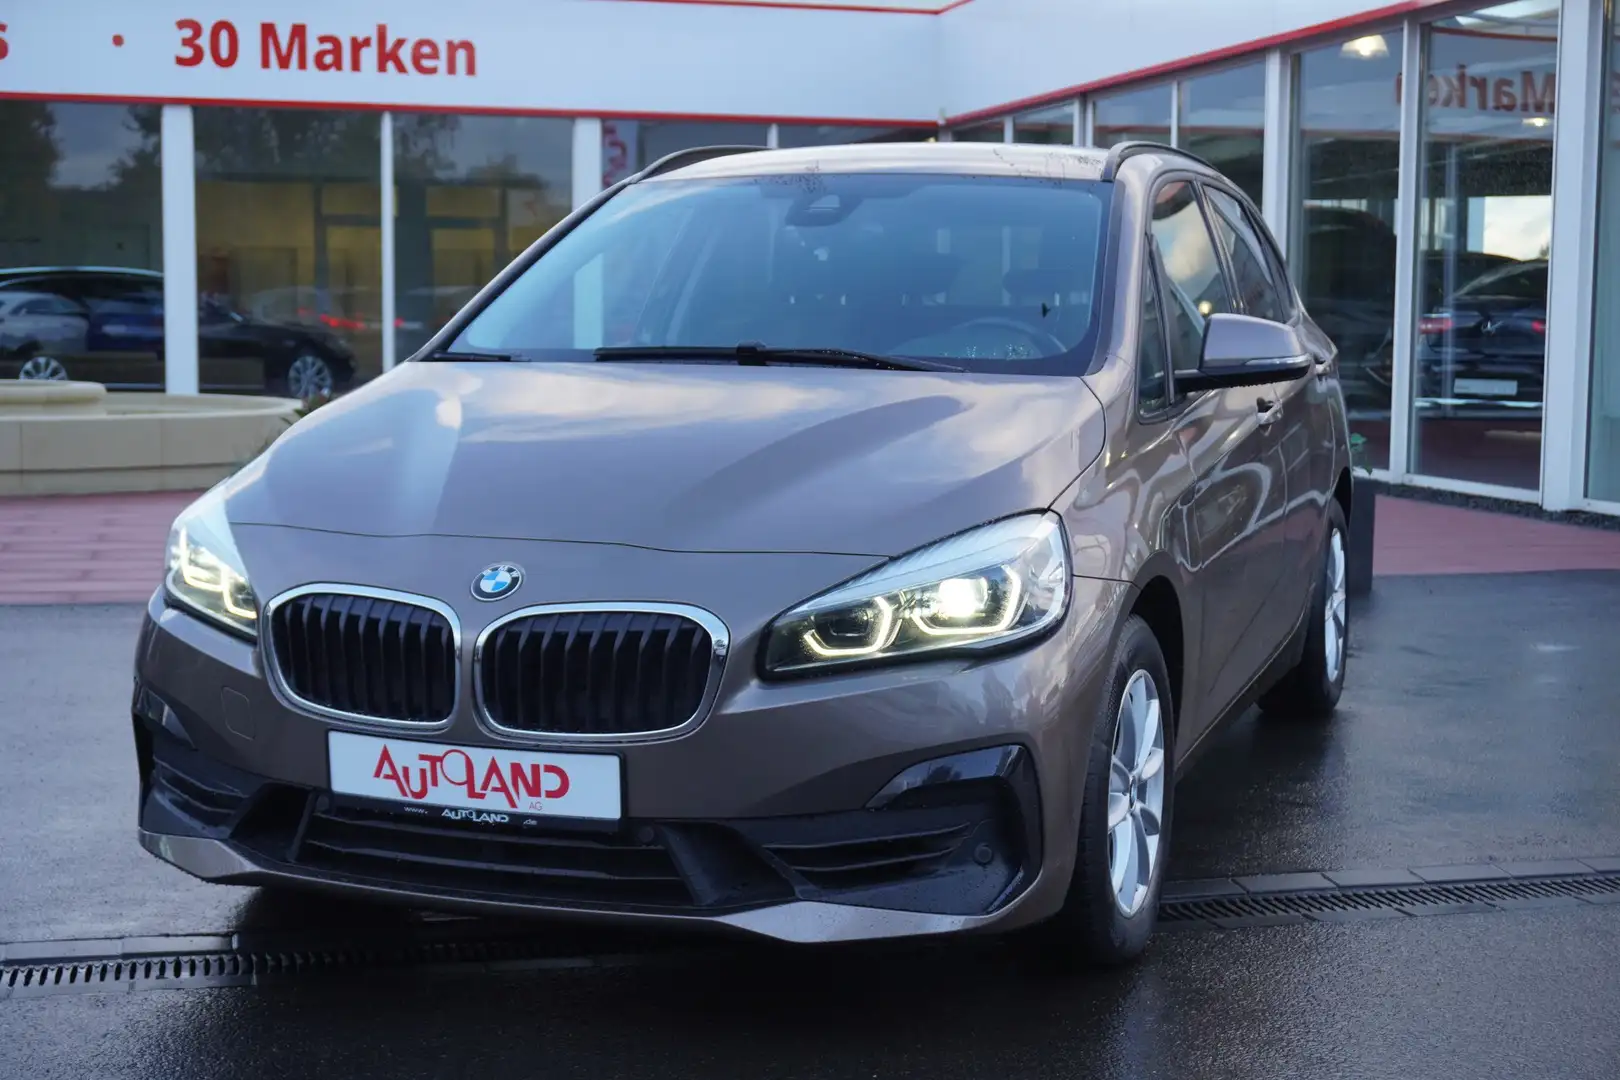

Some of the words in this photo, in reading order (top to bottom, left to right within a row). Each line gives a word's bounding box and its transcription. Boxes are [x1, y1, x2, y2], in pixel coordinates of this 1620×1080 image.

[174, 18, 239, 68] 30
[260, 23, 477, 76] Marken
[528, 802, 543, 812] AG
